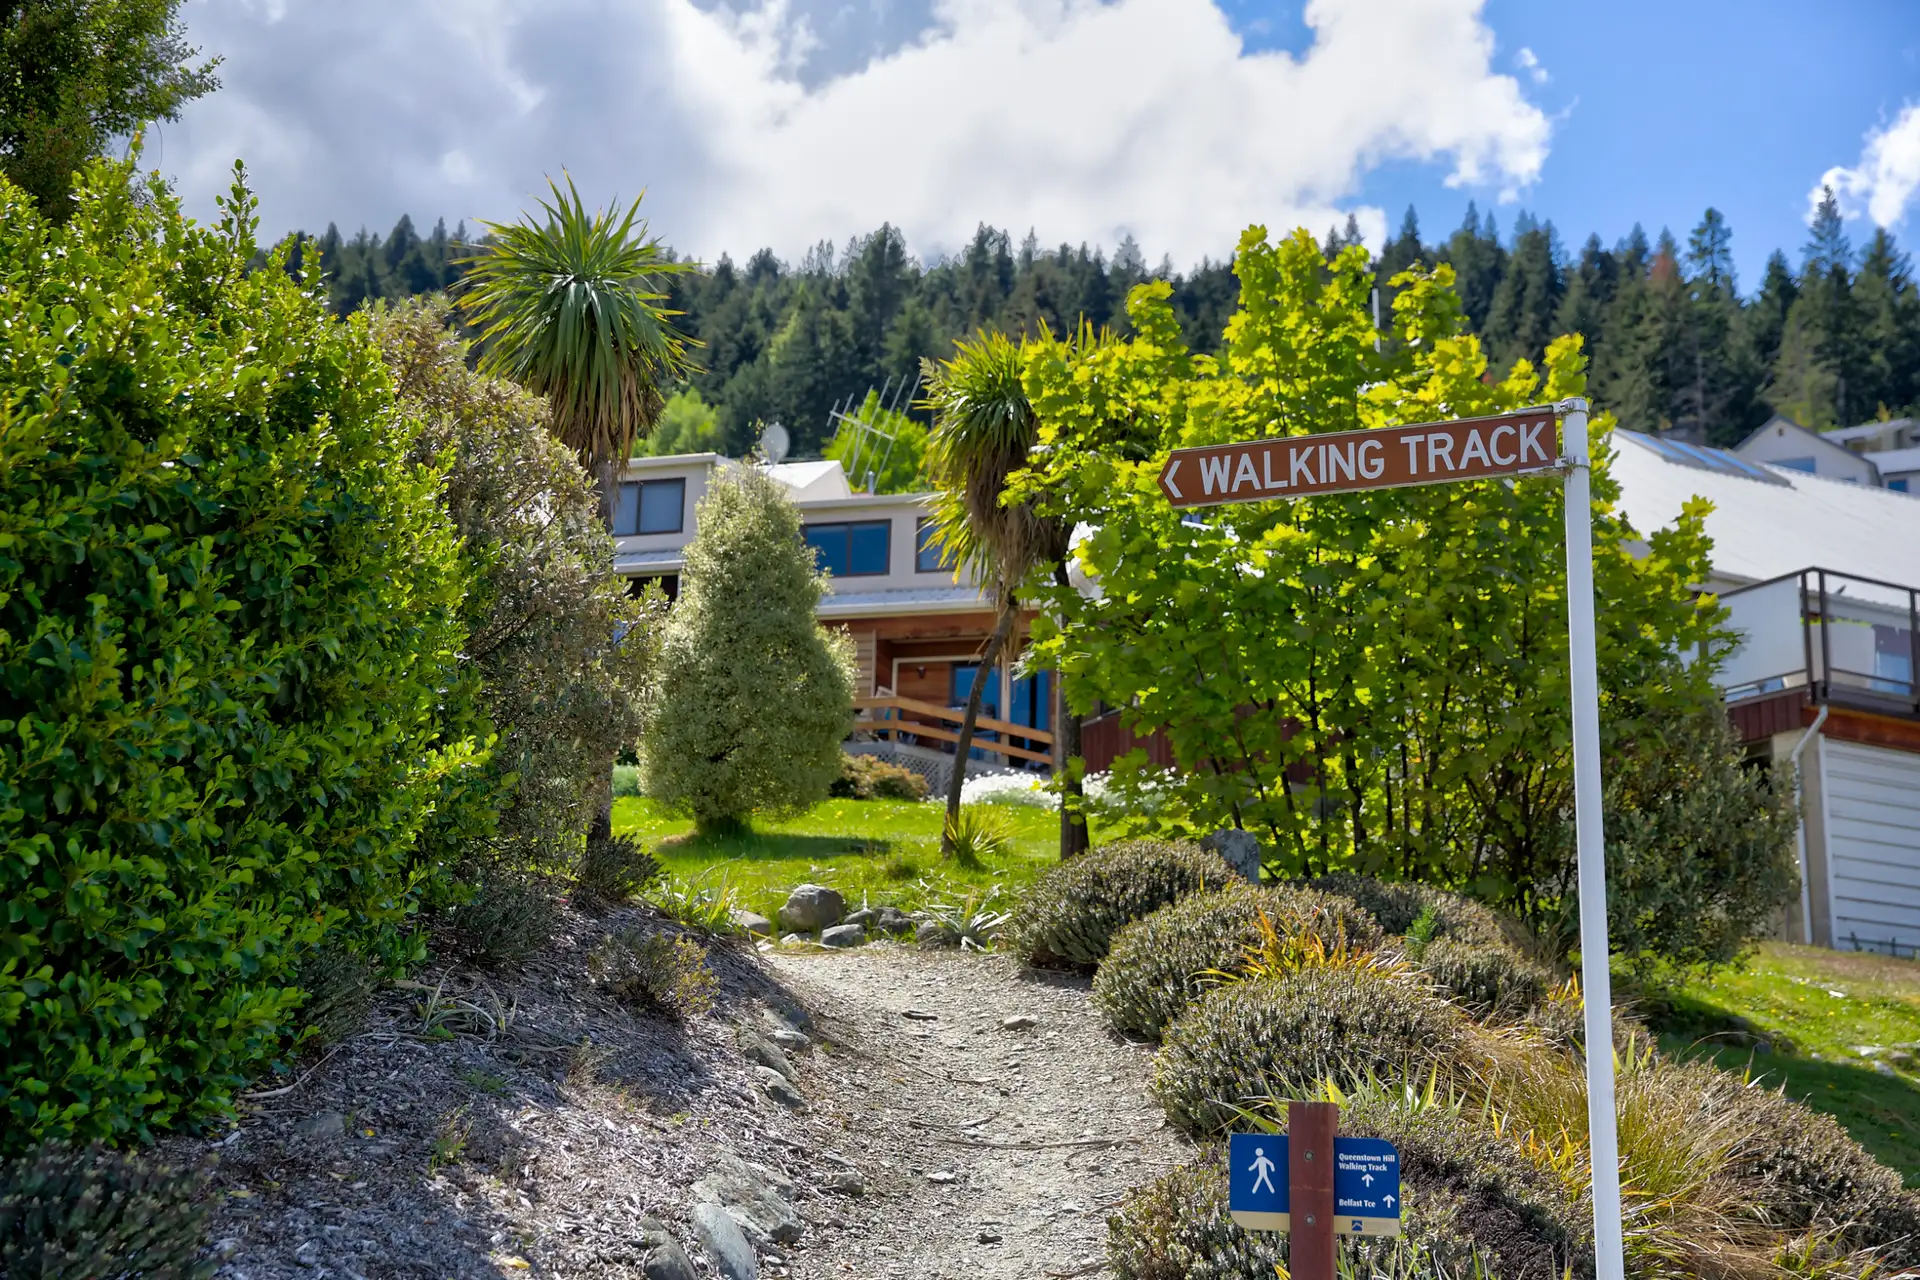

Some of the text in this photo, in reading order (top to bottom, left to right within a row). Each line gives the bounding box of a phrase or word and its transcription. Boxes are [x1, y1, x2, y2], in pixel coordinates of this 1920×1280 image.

[1199, 421, 1547, 496] WALKING TRACK
[1339, 1153, 1395, 1162] Queenstown Hill
[1339, 1162, 1387, 1172] Walking Track
[1339, 1199, 1376, 1208] Belfast Tce
